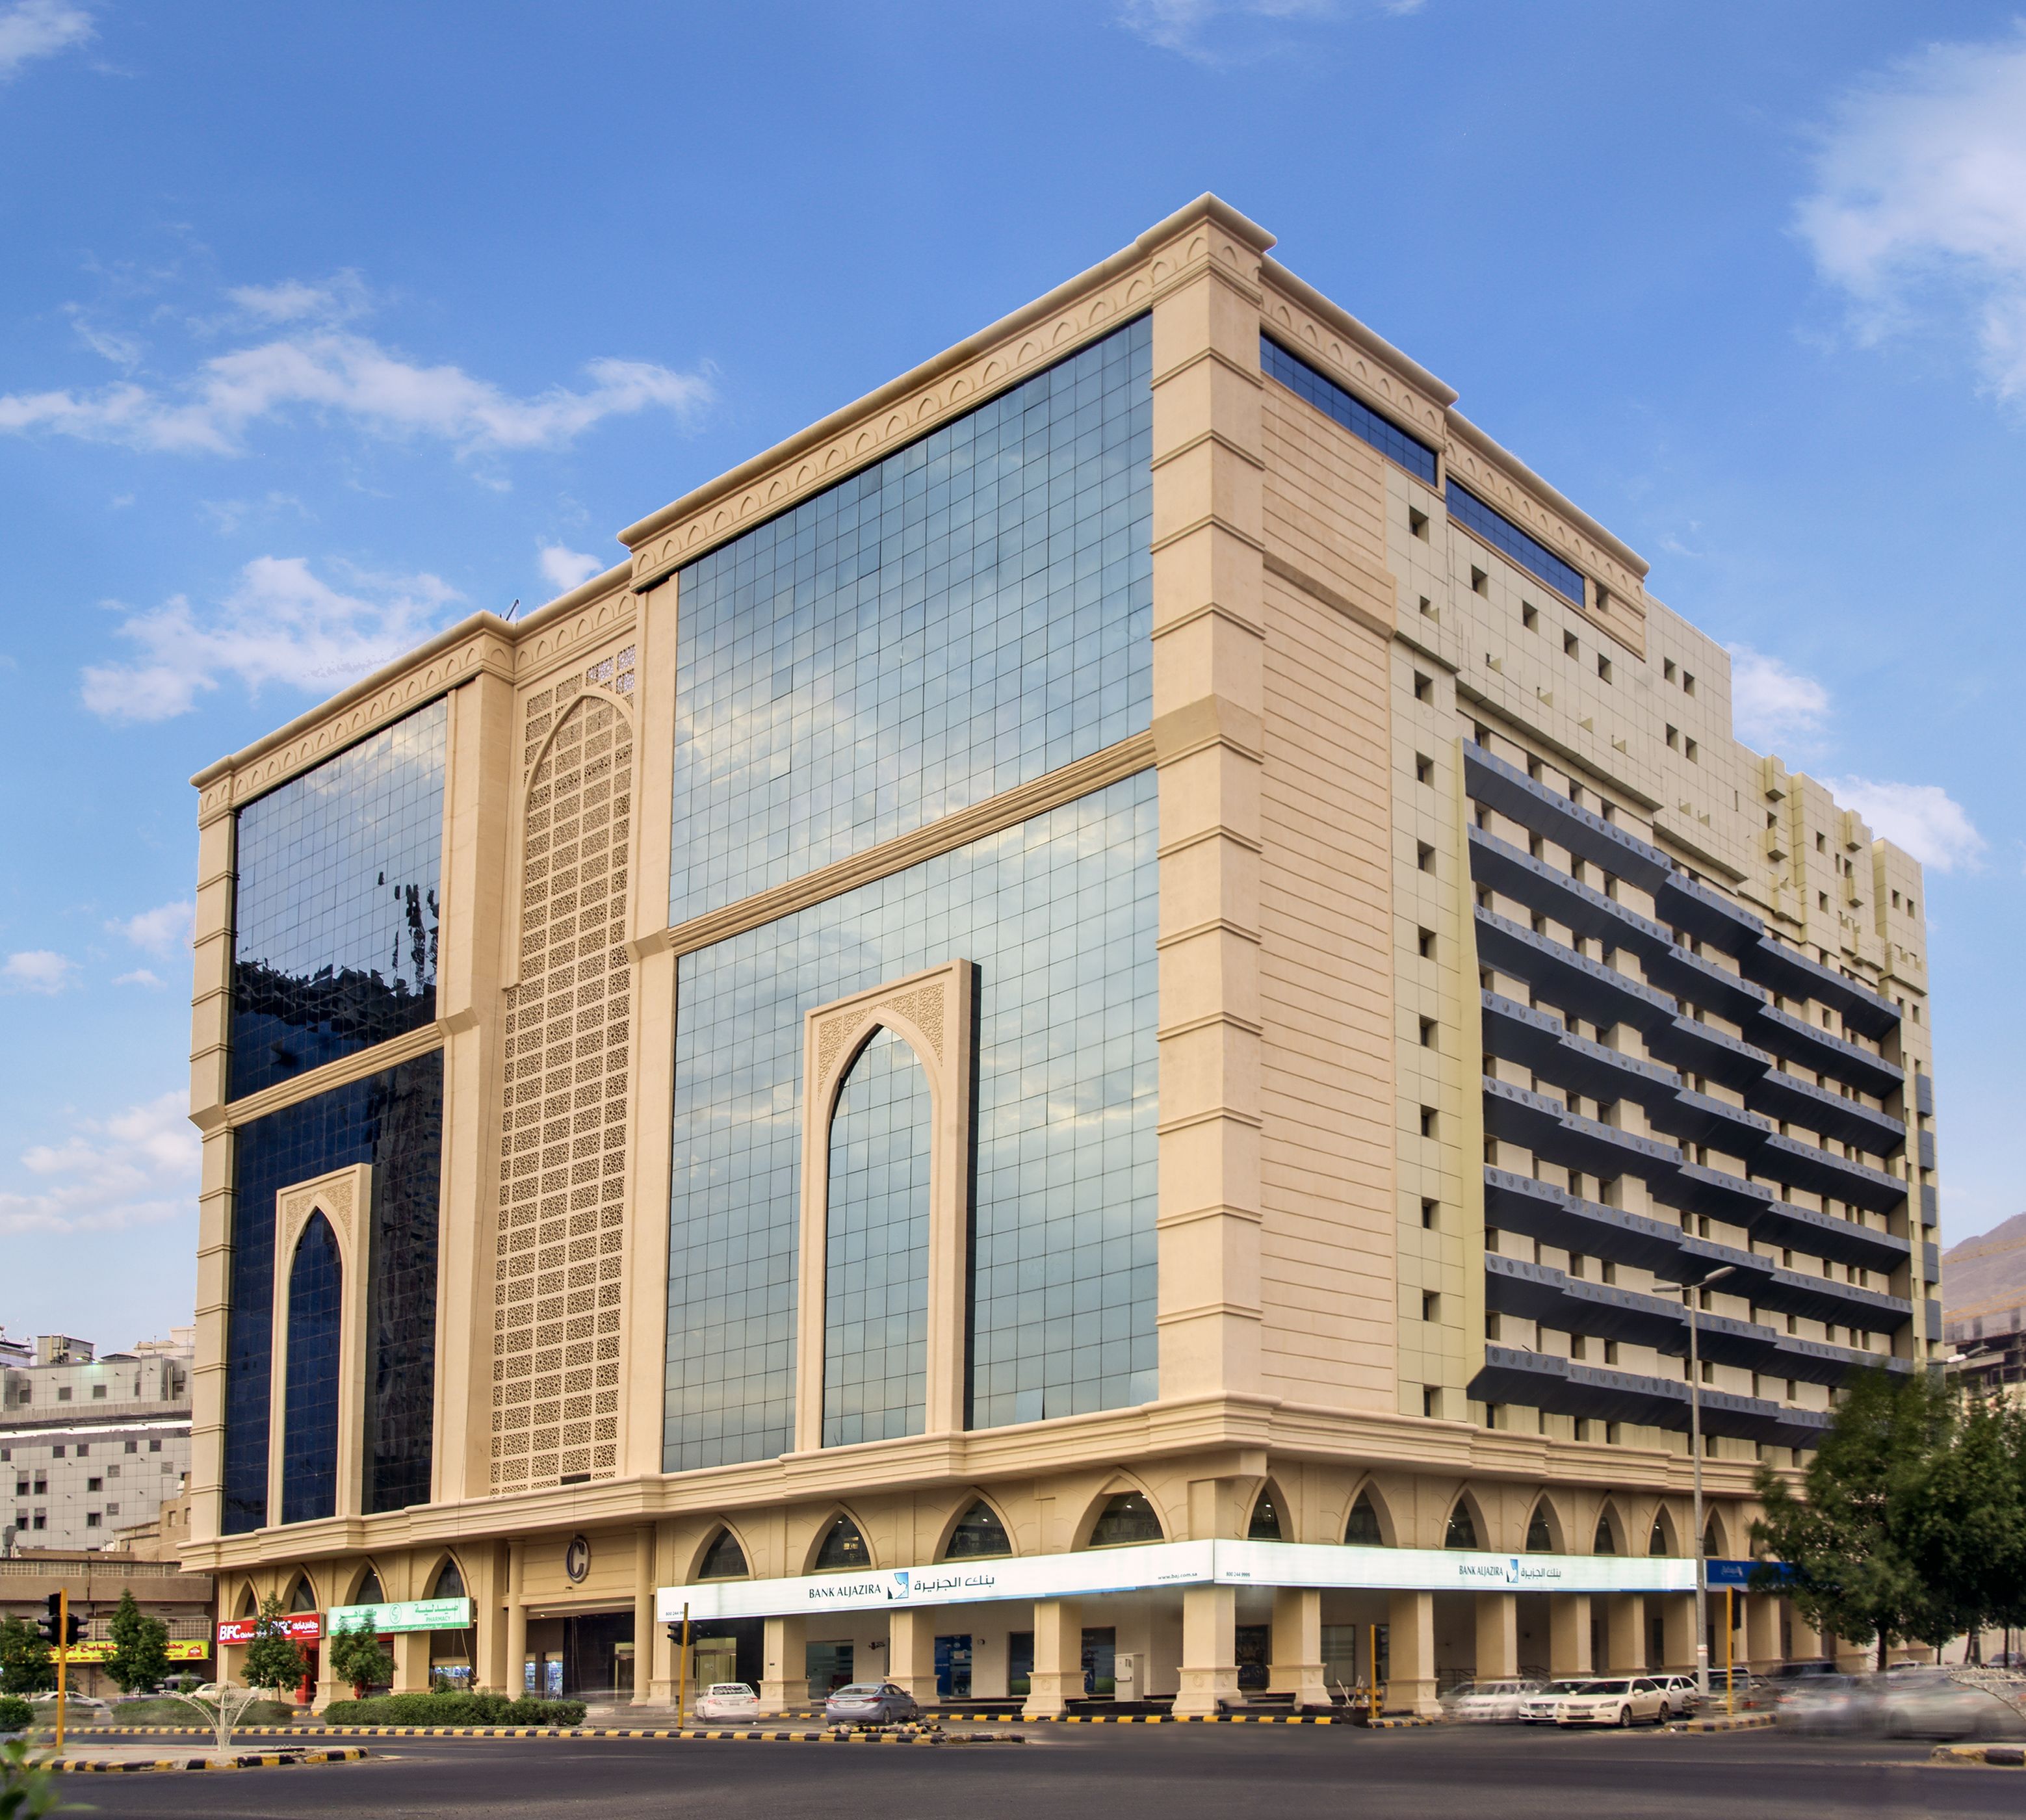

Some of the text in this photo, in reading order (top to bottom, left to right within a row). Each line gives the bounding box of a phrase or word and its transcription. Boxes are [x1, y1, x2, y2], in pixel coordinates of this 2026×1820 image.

[1459, 1565, 1503, 1577] BANK ALJAZIRA
[1520, 1567, 1561, 1580] بنك الجزيرة
[914, 1575, 994, 1592] بنك الجزيرة
[809, 1584, 881, 1598] BANK ALJAZIRA
[414, 1604, 458, 1616] صيدلية
[219, 1624, 241, 1641] BFC
